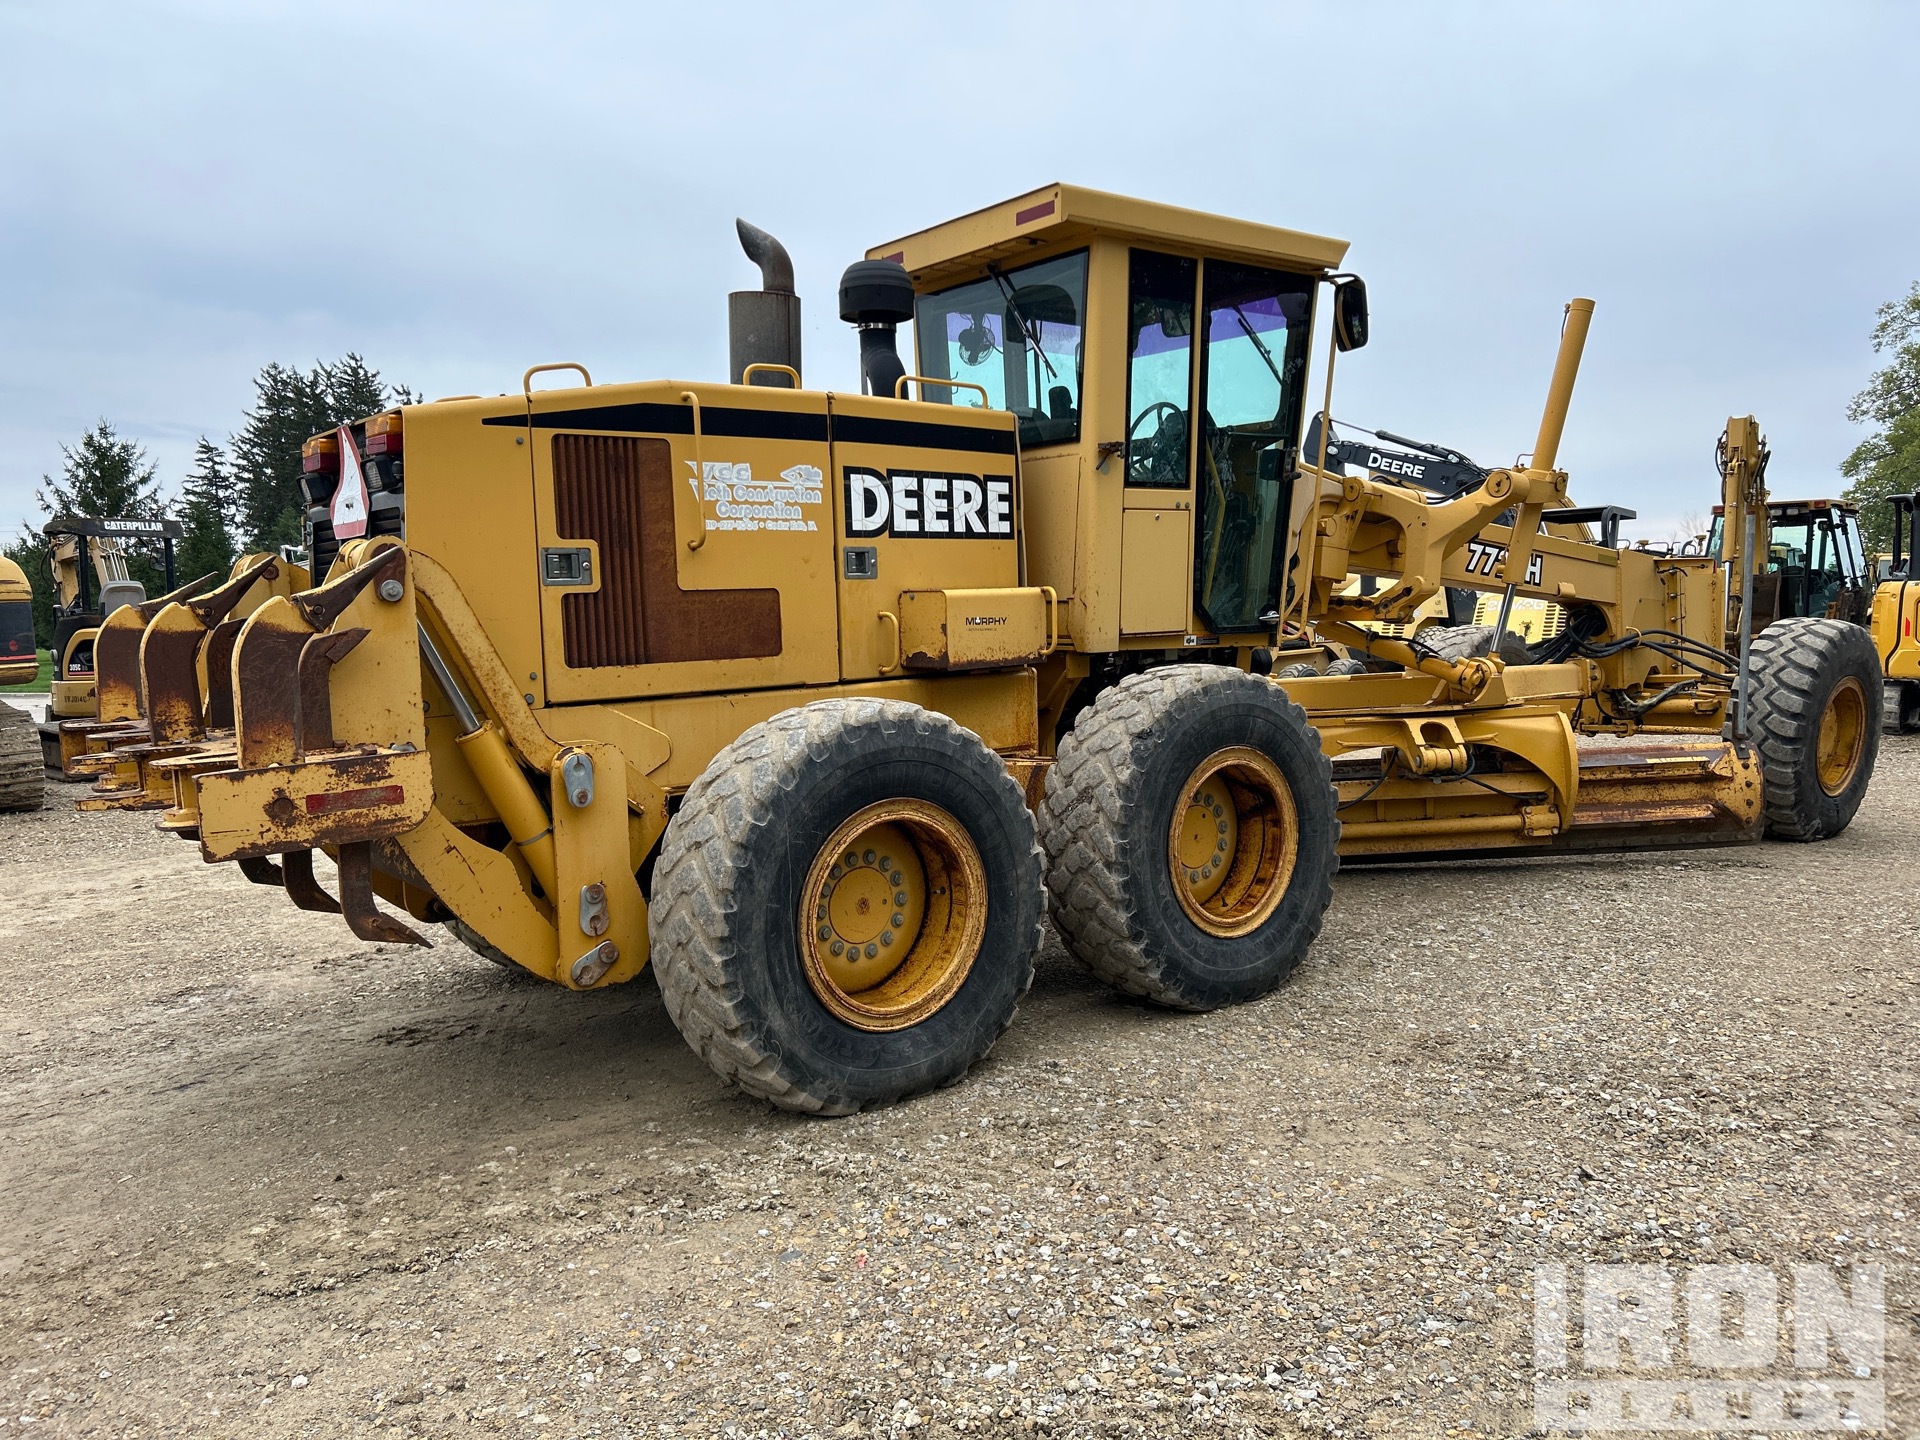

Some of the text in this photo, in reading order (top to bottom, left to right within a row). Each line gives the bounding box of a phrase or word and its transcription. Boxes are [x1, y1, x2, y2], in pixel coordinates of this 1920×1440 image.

[1367, 452, 1426, 479] DEERE
[733, 484, 822, 503] Construction
[849, 473, 1011, 533] DEERE
[716, 500, 802, 520] Corporation
[103, 521, 164, 532] CATERPILLAR
[1465, 542, 1542, 586] 77H
[965, 616, 1007, 626] MURPHY
